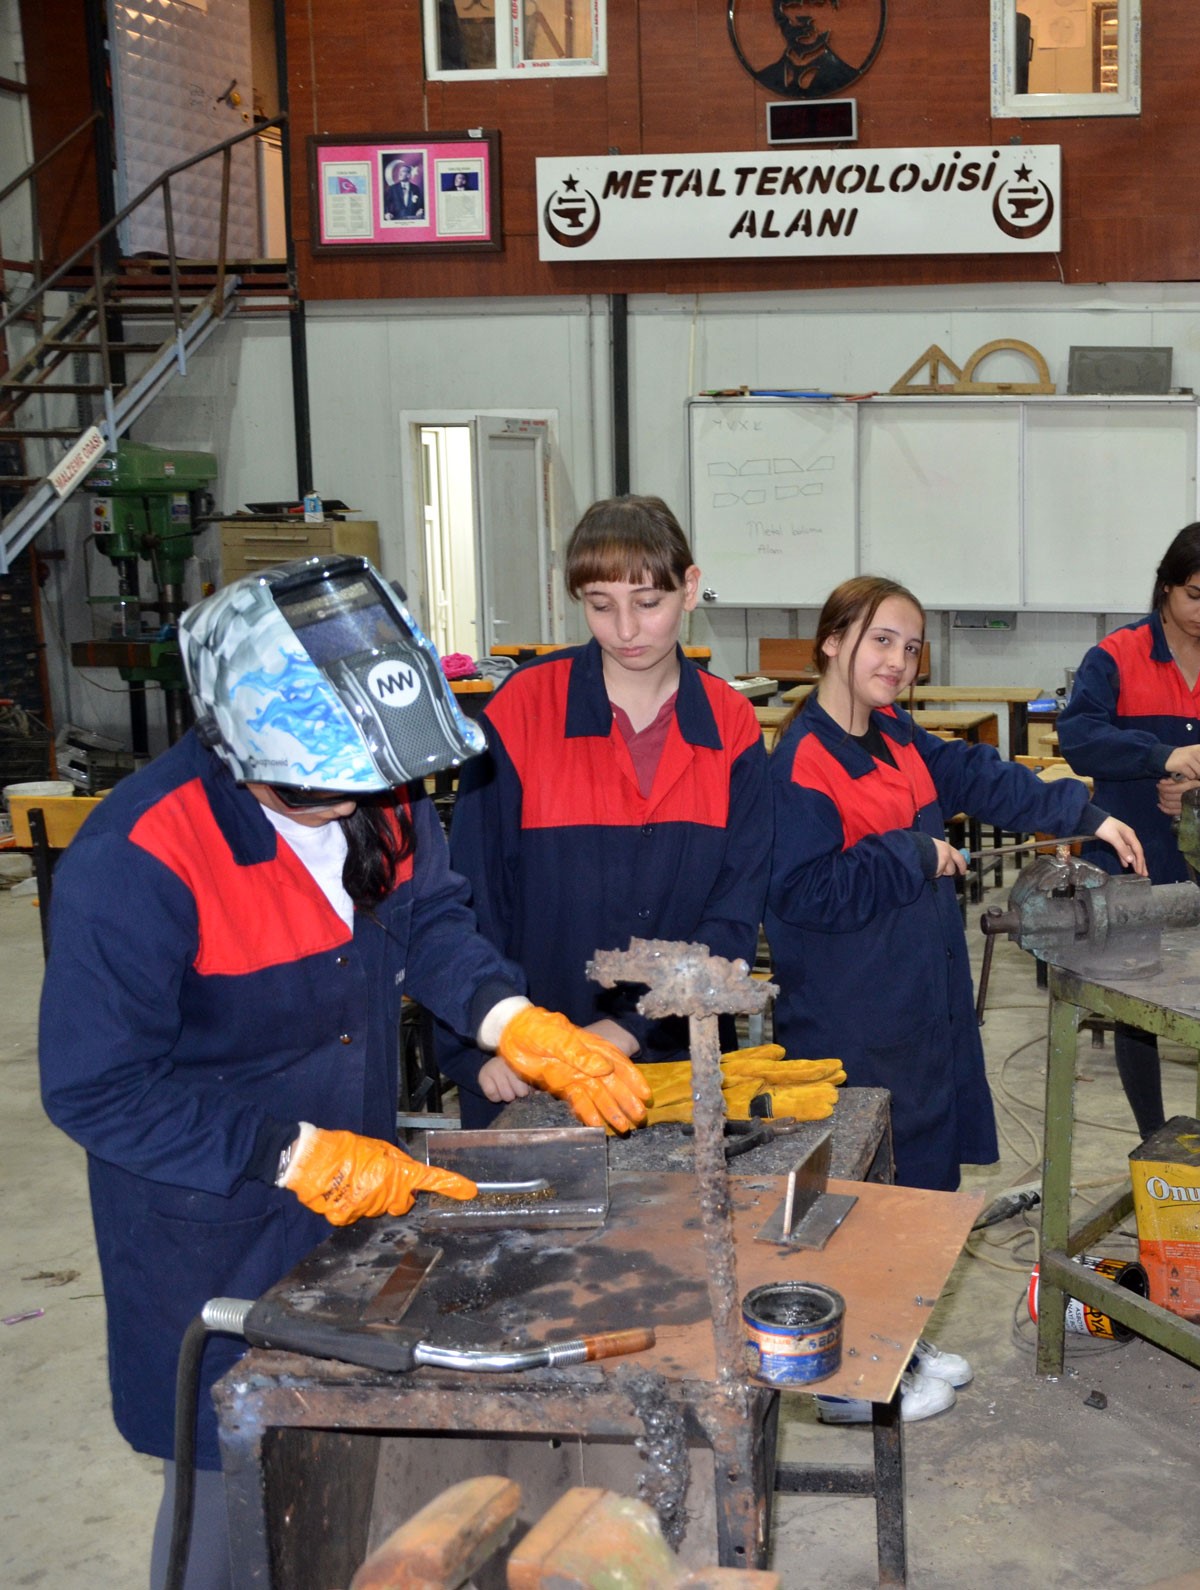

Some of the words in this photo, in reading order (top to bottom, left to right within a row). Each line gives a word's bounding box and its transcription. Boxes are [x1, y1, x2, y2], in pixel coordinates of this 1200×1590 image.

[602, 168, 726, 200] METAL
[734, 150, 1000, 196] TEKNOLOJİSİ
[729, 207, 858, 239] ALANI
